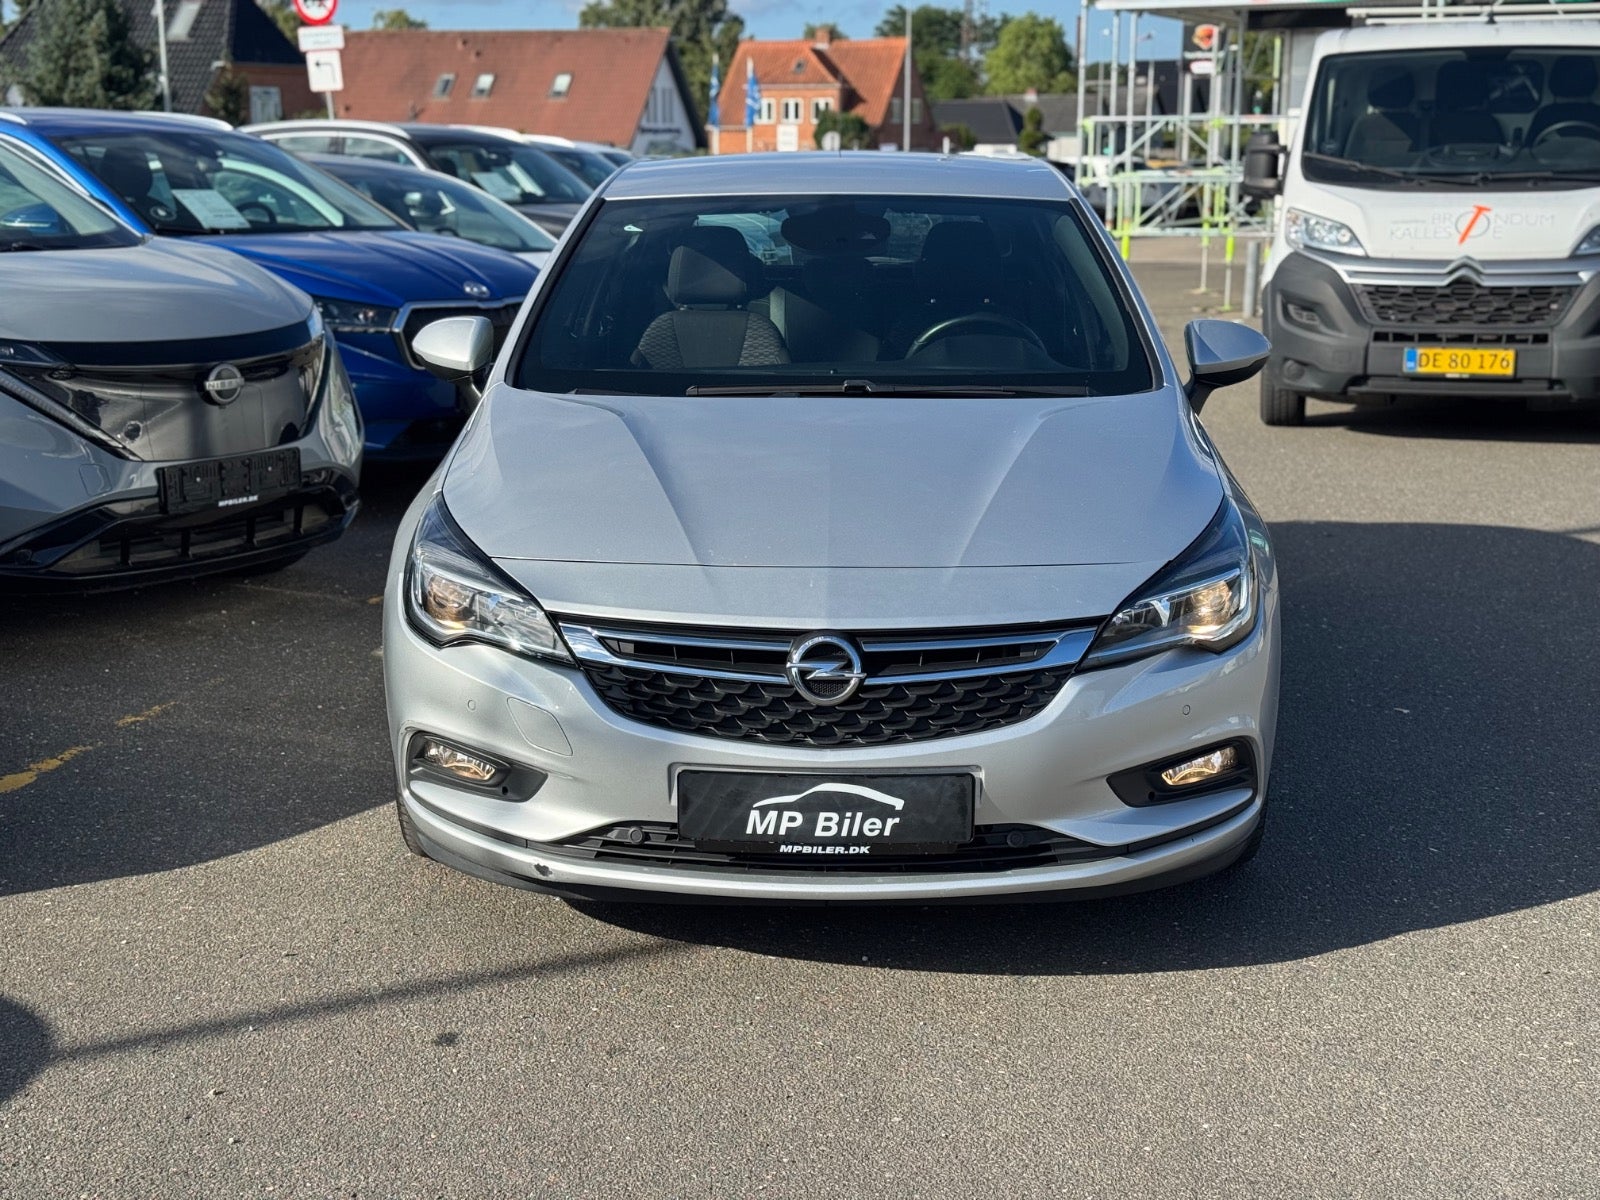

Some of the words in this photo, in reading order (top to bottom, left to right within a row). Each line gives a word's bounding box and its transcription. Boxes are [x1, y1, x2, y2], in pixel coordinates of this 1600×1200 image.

[1418, 352, 1443, 368] DE
[1448, 352, 1471, 369] 80
[1478, 353, 1510, 370] 176
[745, 809, 804, 836] MP
[814, 811, 901, 837] Biler
[779, 844, 872, 855] MPBILER.DK
